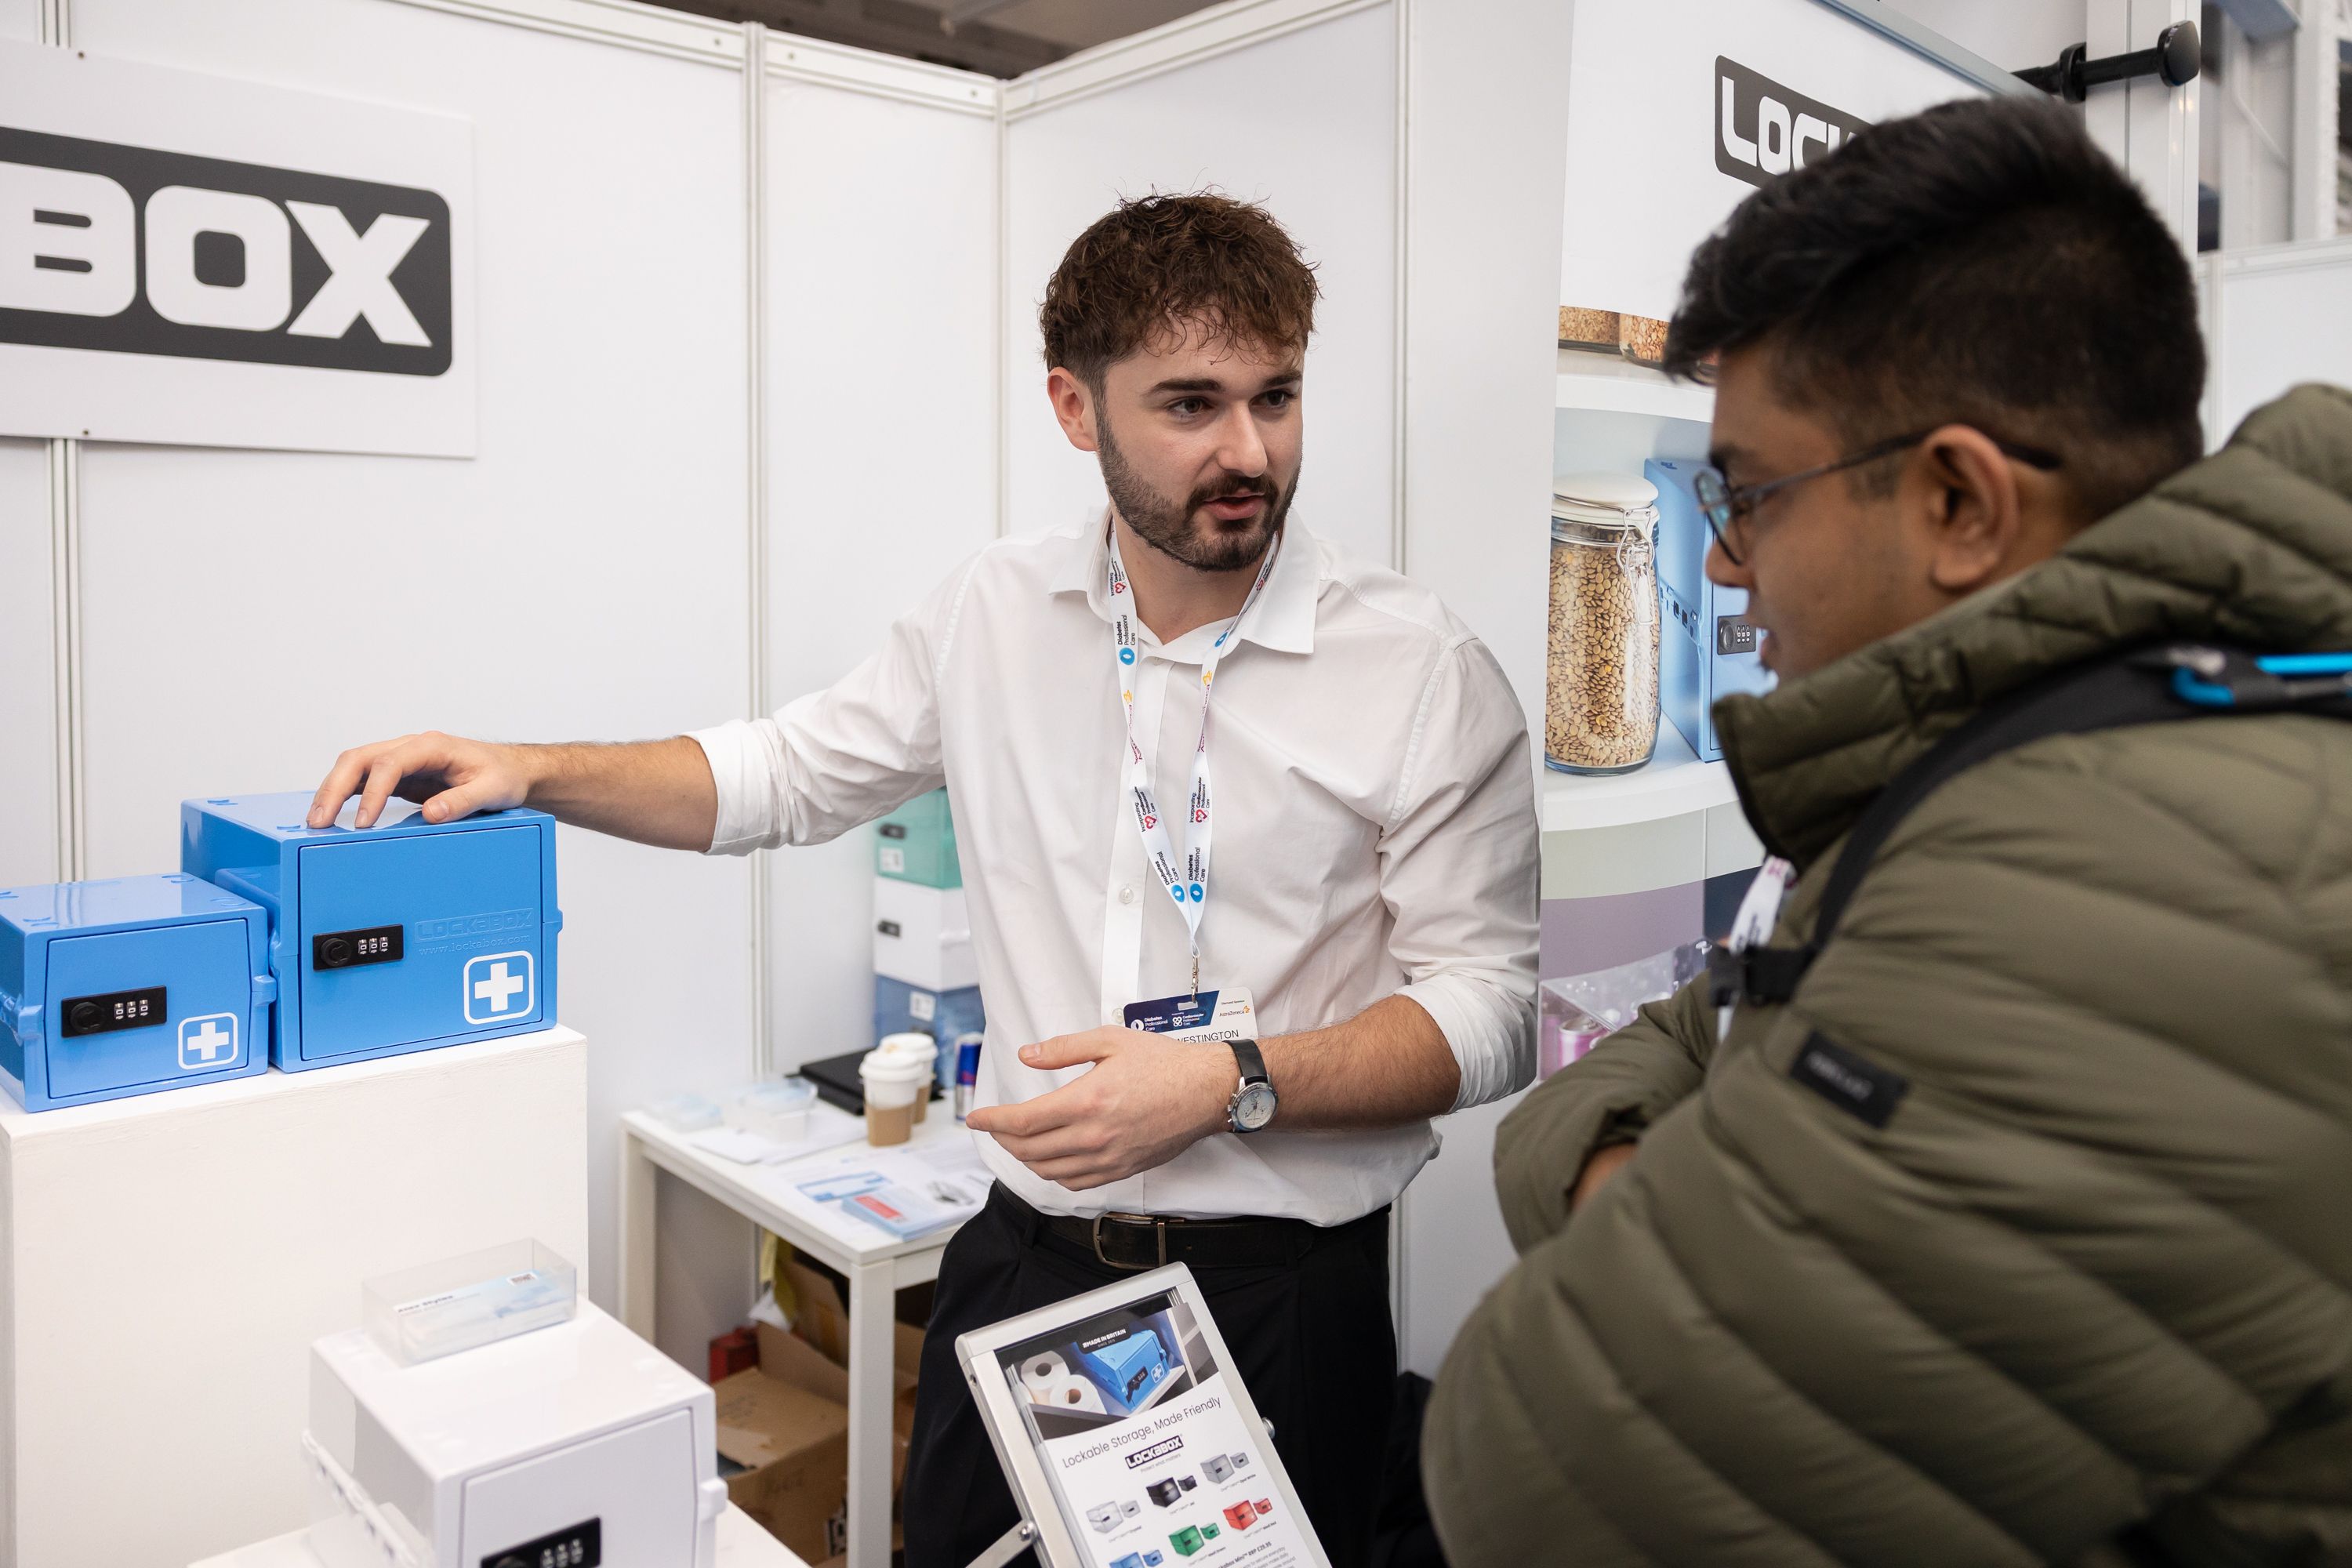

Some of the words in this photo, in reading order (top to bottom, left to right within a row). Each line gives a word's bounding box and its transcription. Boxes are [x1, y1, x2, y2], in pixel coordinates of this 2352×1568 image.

[1155, 861, 1170, 886] Diabetes
[1157, 851, 1174, 884] Professional
[419, 934, 531, 956] www.lockabox.com
[1062, 1442, 1110, 1468] Lockable
[1111, 1425, 1155, 1448] Storage,
[1154, 1412, 1183, 1431] Made
[1184, 1396, 1222, 1417] Friendly
